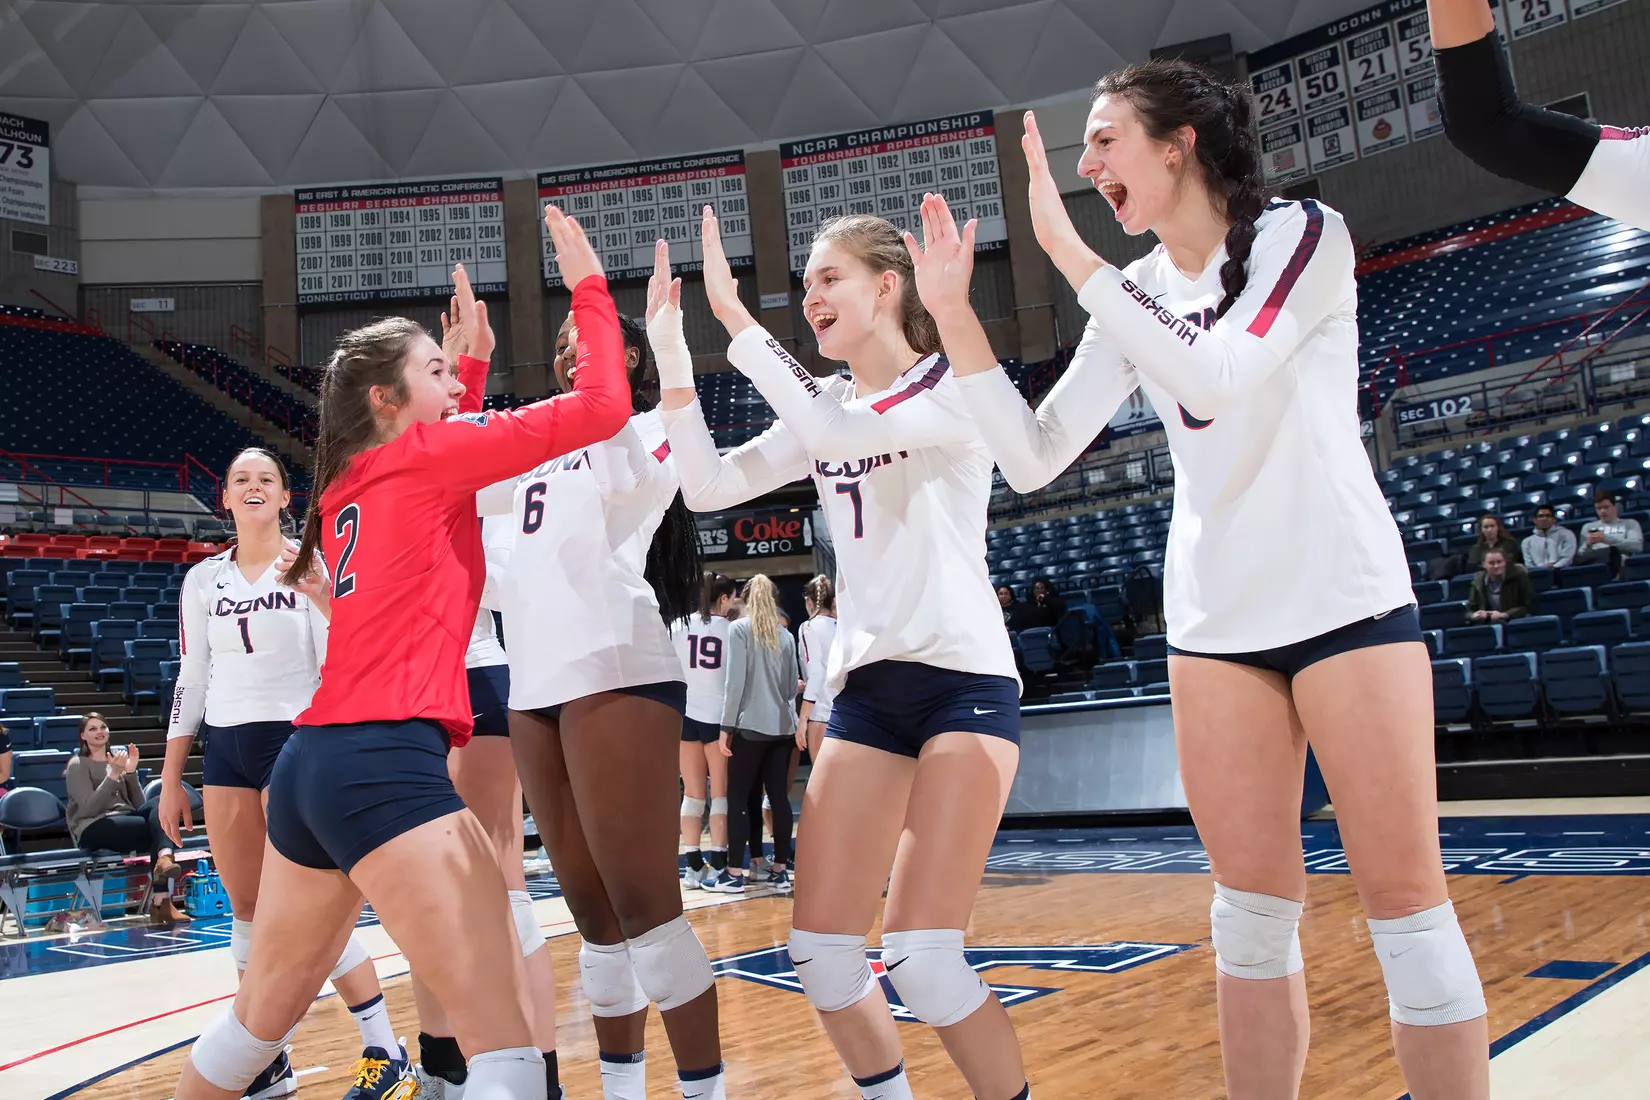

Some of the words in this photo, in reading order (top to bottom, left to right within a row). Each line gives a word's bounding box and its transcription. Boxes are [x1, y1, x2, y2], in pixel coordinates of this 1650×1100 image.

[1328, 9, 1381, 36] UCONN
[1521, 0, 1551, 23] 25
[1358, 52, 1387, 82] 21
[1306, 70, 1339, 100] 50
[1259, 87, 1292, 117] 24
[0, 116, 24, 128] ACH
[792, 138, 838, 155] NCAA
[847, 115, 981, 146] CHAMPIONSHIP
[792, 144, 880, 167] TOURNAMENT
[887, 127, 985, 151] APPEARANCES
[542, 176, 556, 184] BIG
[558, 174, 581, 182] EAST
[584, 172, 590, 180] &
[593, 167, 638, 178] AMERICAN
[640, 162, 681, 174] ATHLETIC
[684, 154, 740, 168] CONFERENCE
[787, 168, 808, 184] 1989
[817, 164, 838, 179] 1990
[848, 159, 868, 174] 1991
[877, 154, 899, 170] 1992
[908, 150, 930, 165] 1993
[939, 145, 960, 160] 1994
[970, 140, 992, 155] 1995
[299, 192, 313, 200] BIG
[316, 190, 338, 199] EAST
[342, 190, 348, 198] &
[351, 188, 396, 197] AMERICAN
[398, 184, 440, 194] ATHLETIC
[442, 182, 498, 192] CONFERENCE
[558, 178, 643, 195] TOURNAMENT
[650, 168, 726, 184] CHAMPIONS
[574, 196, 593, 210] 1991
[602, 192, 624, 206] 1994
[632, 188, 652, 202] 1995
[662, 185, 682, 200] 1996
[692, 182, 712, 196] 1997
[720, 178, 742, 192] 1998
[789, 189, 810, 205] 1996
[820, 184, 840, 200] 1997
[849, 180, 871, 196] 1998
[879, 175, 901, 190] 1999
[909, 170, 933, 186] 2000
[940, 166, 963, 180] 2001
[971, 160, 995, 176] 2002
[300, 202, 358, 212] REGULAR
[366, 198, 416, 208] SEASON
[423, 193, 498, 205] CHAMPIONS
[604, 212, 625, 226] 2001
[632, 208, 655, 224] 2002
[662, 205, 685, 220] 2005
[722, 198, 745, 213] 2008
[790, 210, 813, 226] 2003
[850, 200, 874, 215] 2005
[881, 196, 904, 212] 2006
[942, 186, 966, 202] 2008
[974, 182, 998, 198] 2009
[976, 202, 998, 218] 2016
[300, 216, 321, 230] 1989
[330, 214, 351, 228] 1990
[360, 212, 380, 226] 1991
[390, 210, 410, 224] 1994
[419, 208, 440, 222] 1995
[448, 207, 470, 220] 1996
[479, 205, 499, 218] 1997
[301, 236, 322, 250] 1998
[330, 234, 352, 248] 1999
[360, 232, 382, 246] 2000
[390, 230, 411, 244] 2001
[420, 228, 442, 242] 2002
[448, 226, 472, 240] 2003
[478, 226, 501, 238] 2004
[606, 232, 626, 247] 2011
[635, 229, 656, 244] 2012
[664, 226, 686, 240] 2014
[724, 219, 746, 234] 2016
[53, 260, 76, 272] 223
[301, 256, 322, 270] 2007
[330, 254, 352, 268] 2008
[360, 252, 383, 266] 2009
[390, 251, 412, 264] 2010
[421, 248, 442, 262] 2011
[450, 247, 472, 260] 2014
[480, 246, 502, 259] 2015
[608, 253, 629, 268] 2019
[302, 276, 322, 290] 2016
[332, 274, 352, 288] 2017
[361, 272, 382, 286] 2018
[391, 270, 412, 284] 2019
[300, 292, 374, 304] CONNECTICUT
[380, 288, 430, 299] WOMEN'S
[1120, 279, 1199, 347] HUSKIES
[765, 338, 822, 398] HUSKIES
[1400, 408, 1426, 421] SEC
[1429, 396, 1473, 418] 102
[522, 481, 548, 535] 6
[836, 480, 864, 539] 7
[734, 516, 800, 542] Coke
[333, 503, 360, 598] 2
[746, 540, 792, 555] zero
[237, 617, 254, 654] 1
[688, 634, 722, 670] 19
